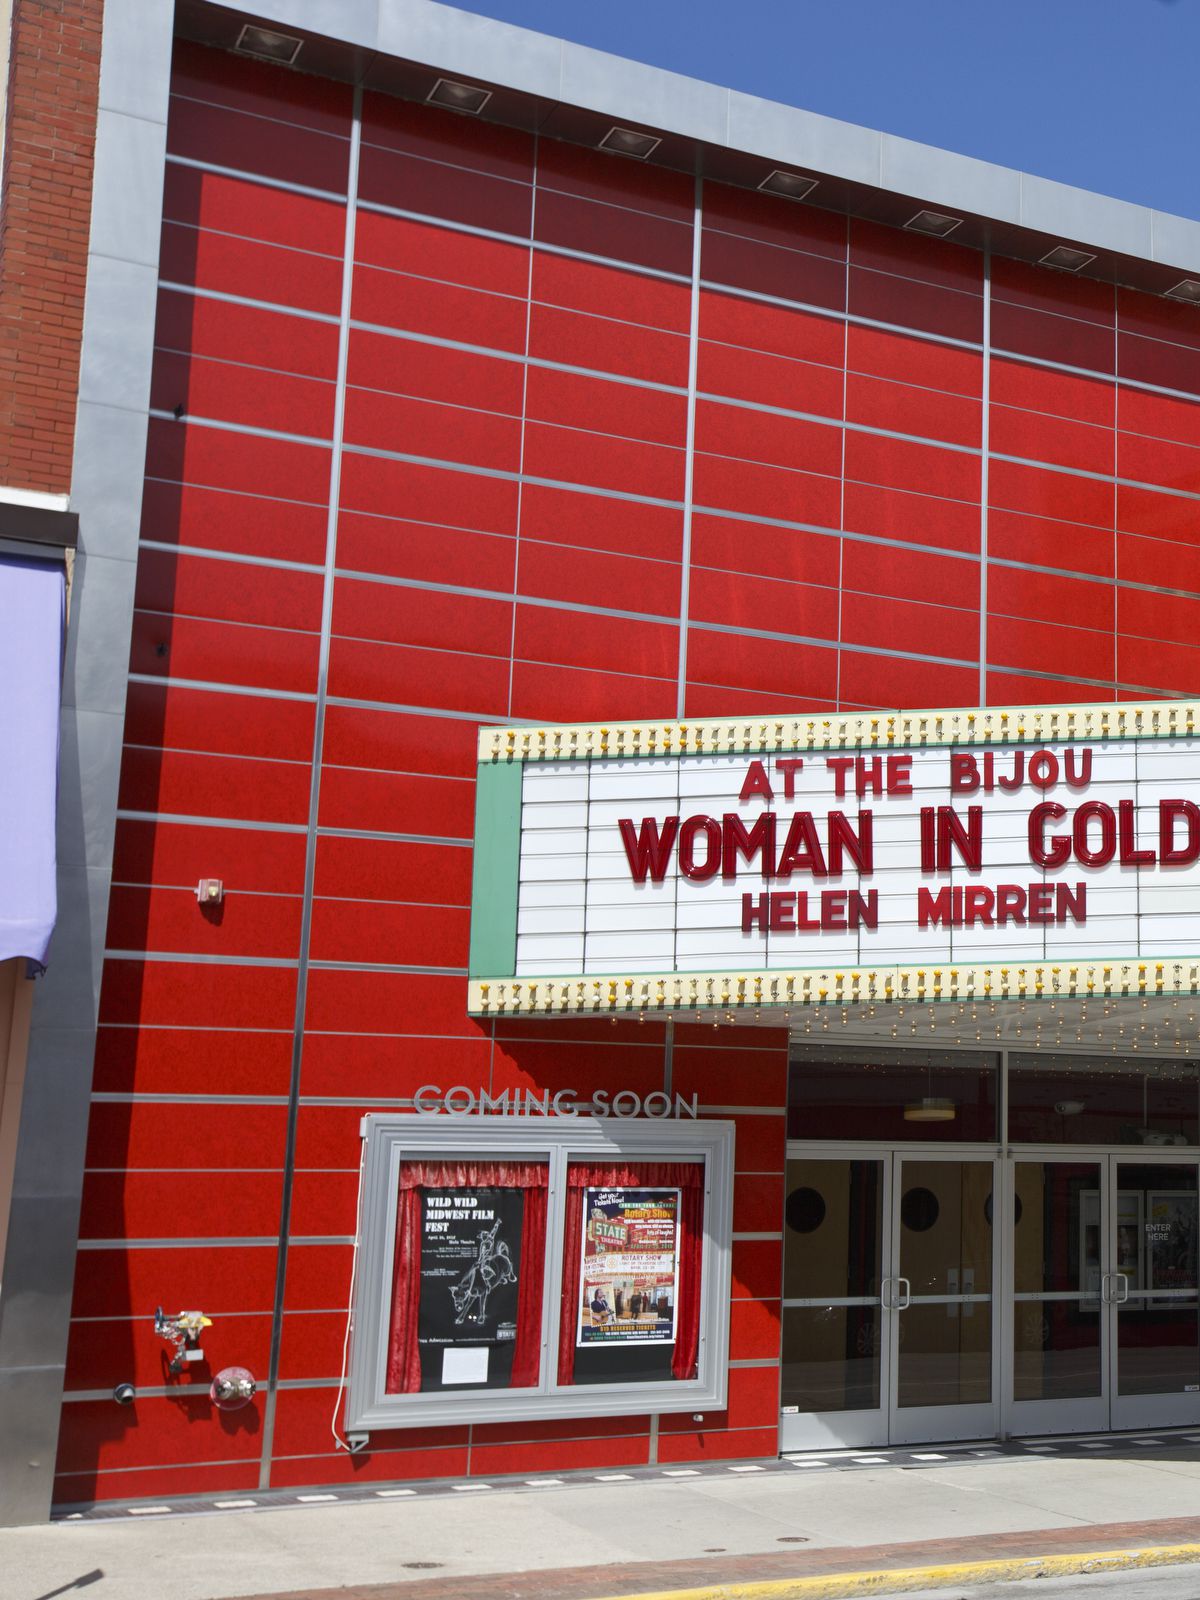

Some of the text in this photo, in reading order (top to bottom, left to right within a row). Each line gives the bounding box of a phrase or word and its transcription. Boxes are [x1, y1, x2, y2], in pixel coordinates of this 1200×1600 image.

[739, 747, 1094, 800] AT THE BIJOU
[618, 808, 875, 883] WOMAN
[920, 805, 984, 872] IN
[741, 881, 1087, 933] HELEN MIRREN
[413, 1085, 699, 1120] COMING SOON
[427, 1197, 478, 1208] WILD WILD
[426, 1210, 494, 1220] MIDWEST FILM
[624, 1208, 674, 1218] Rotary Show
[425, 1222, 449, 1232] FEST
[596, 1222, 627, 1239] STATE
